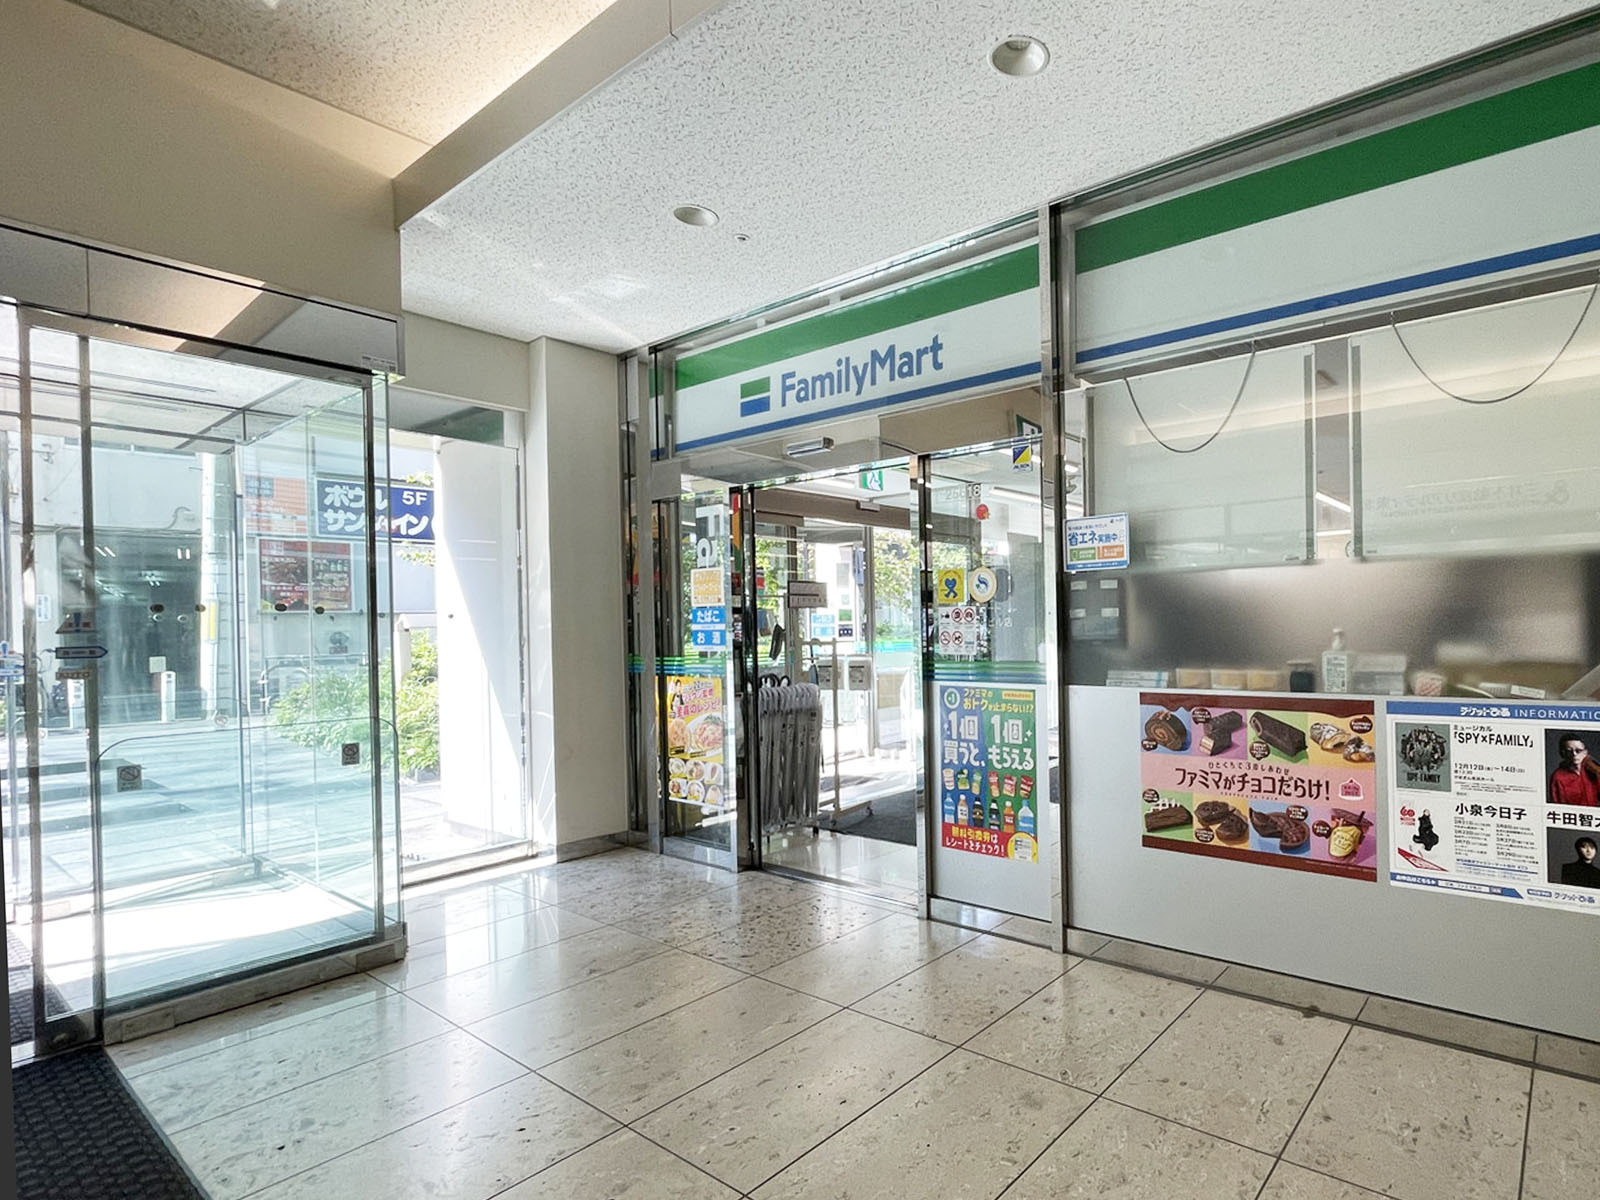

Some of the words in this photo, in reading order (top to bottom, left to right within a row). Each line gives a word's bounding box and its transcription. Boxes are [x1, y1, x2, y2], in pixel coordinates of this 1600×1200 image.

[781, 334, 944, 407] FamilyMart
[402, 490, 427, 505] 5F
[697, 610, 721, 622] たばこ
[948, 711, 978, 740] 1個
[991, 714, 1023, 744] 1個
[988, 745, 1035, 771] もらえる
[1175, 768, 1330, 800] ファミマがチョコだらけ!
[1455, 803, 1527, 820] 小泉今日子
